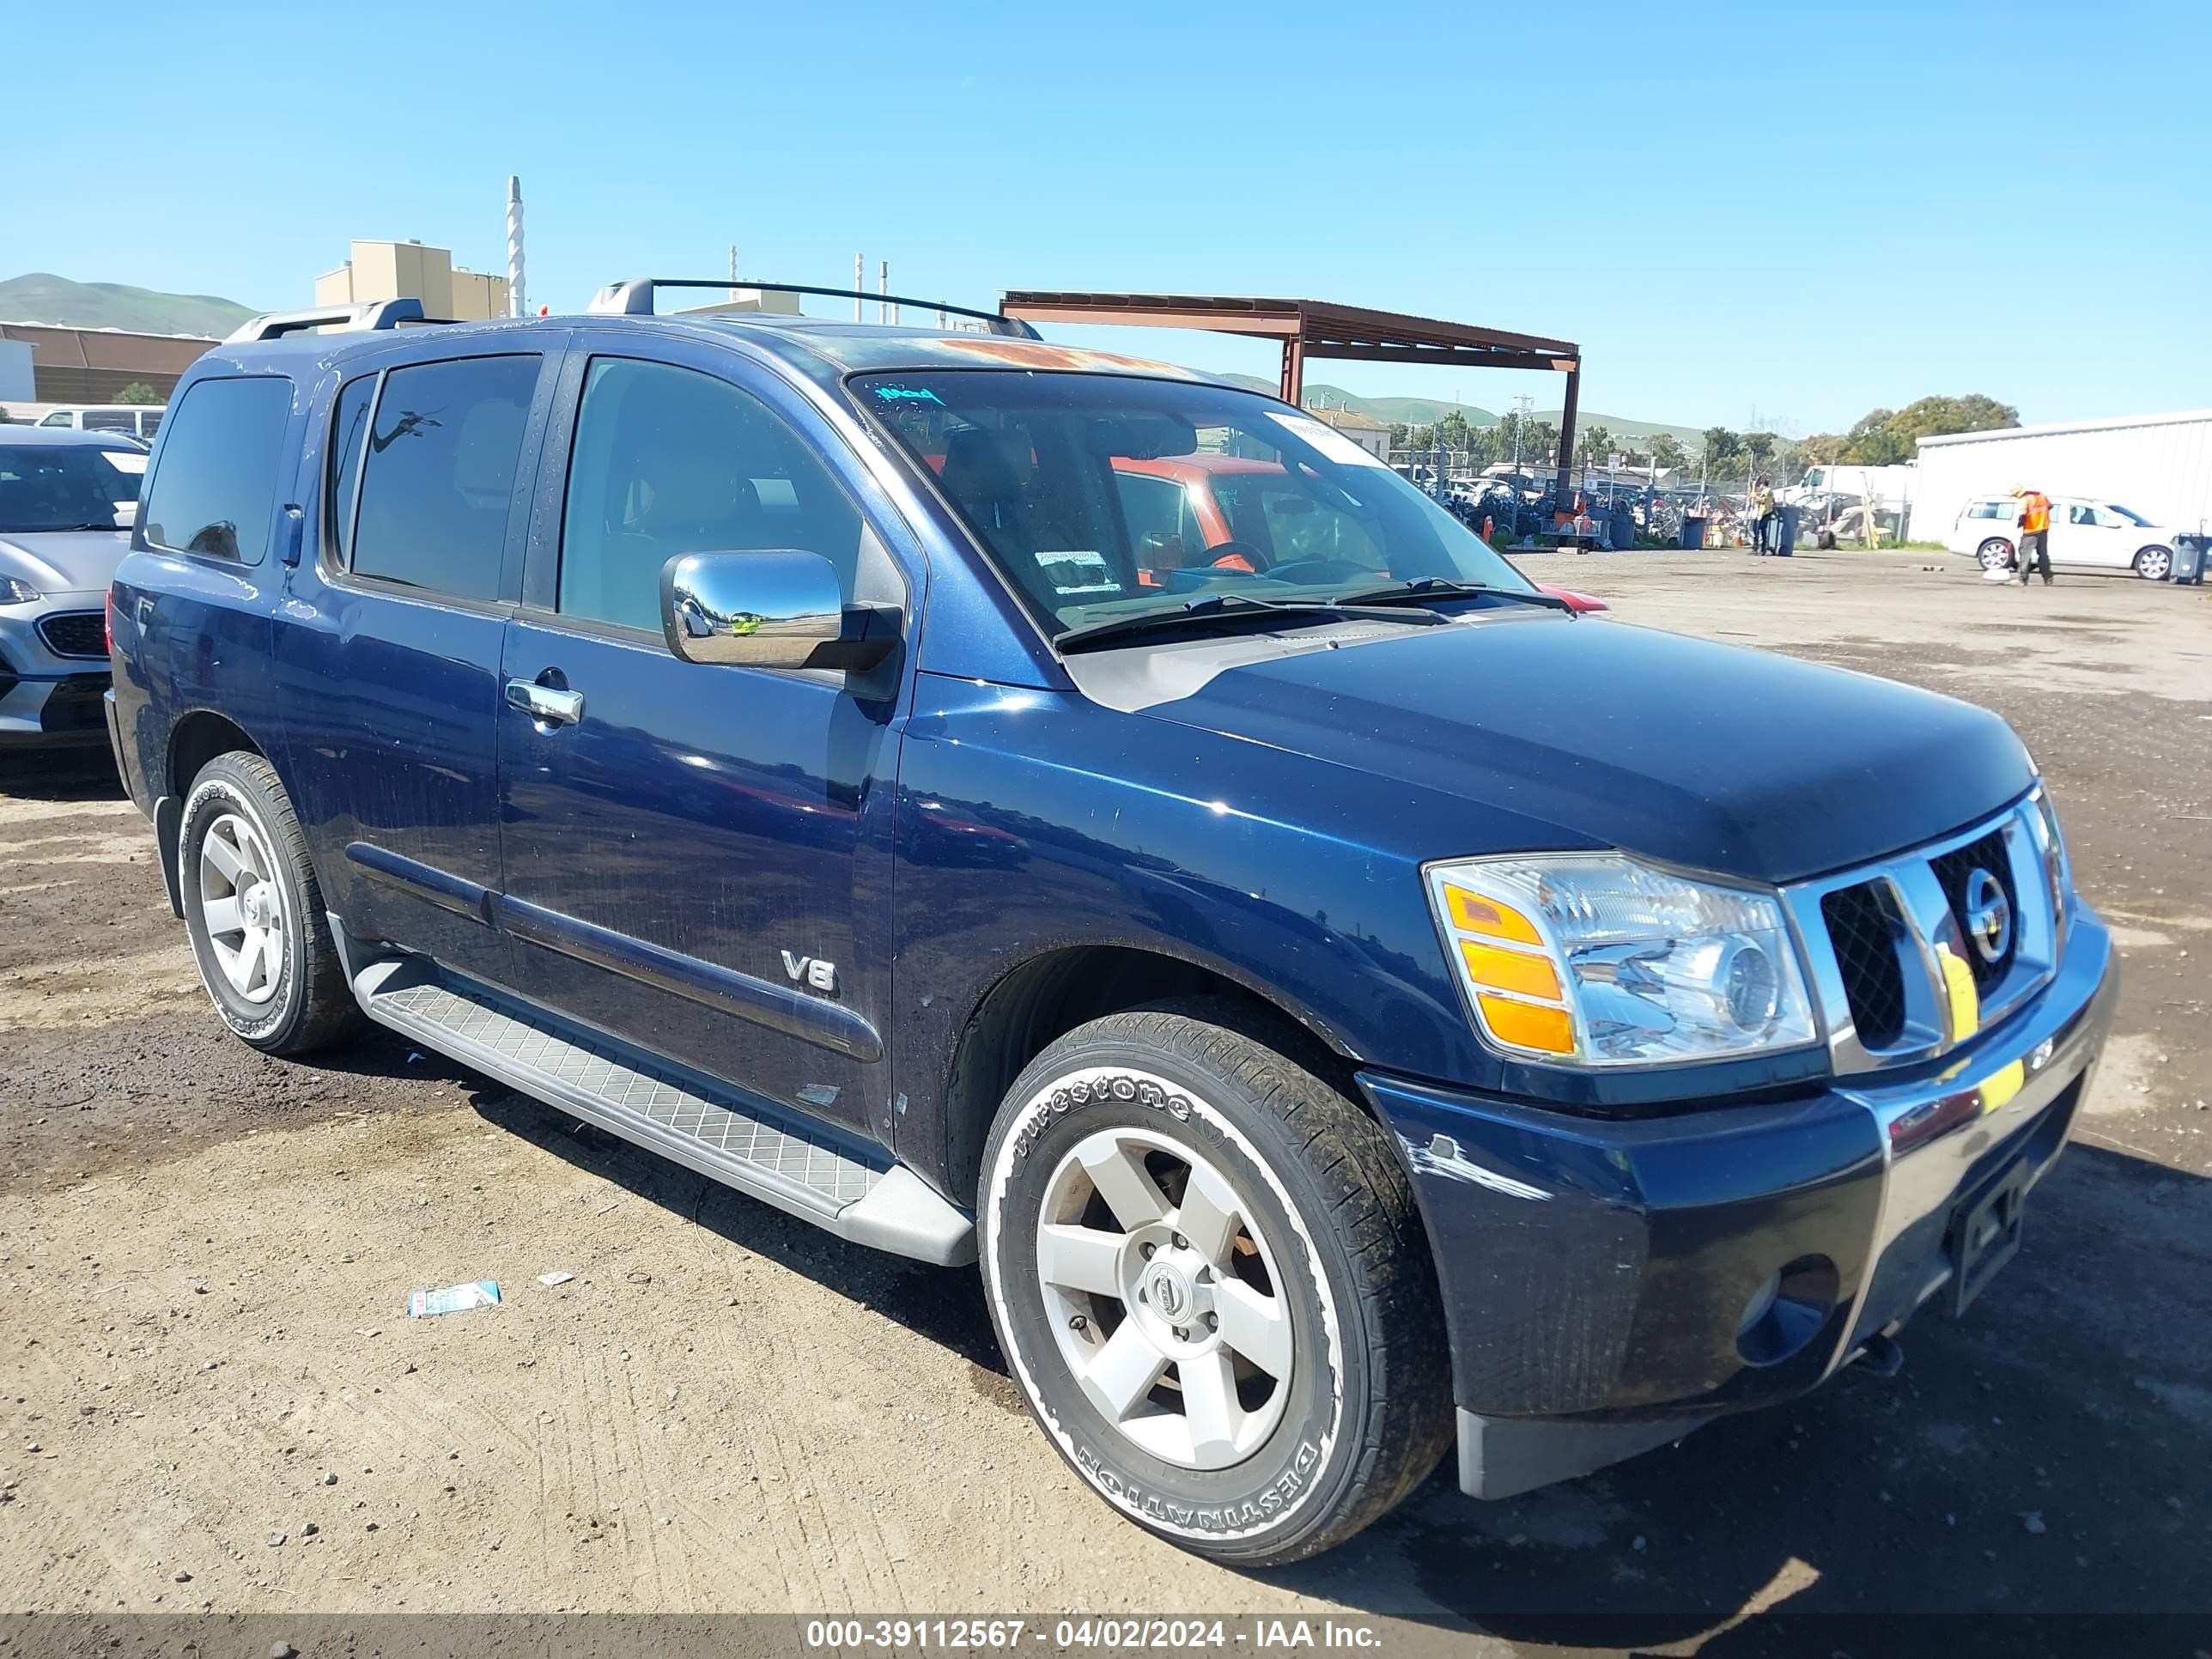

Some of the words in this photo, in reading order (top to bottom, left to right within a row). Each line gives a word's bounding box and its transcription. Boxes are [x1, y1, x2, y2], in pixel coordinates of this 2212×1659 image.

[781, 950, 836, 993] V8
[1013, 1076, 1192, 1158] Firestone
[1078, 1442, 1318, 1529] DESTINATION
